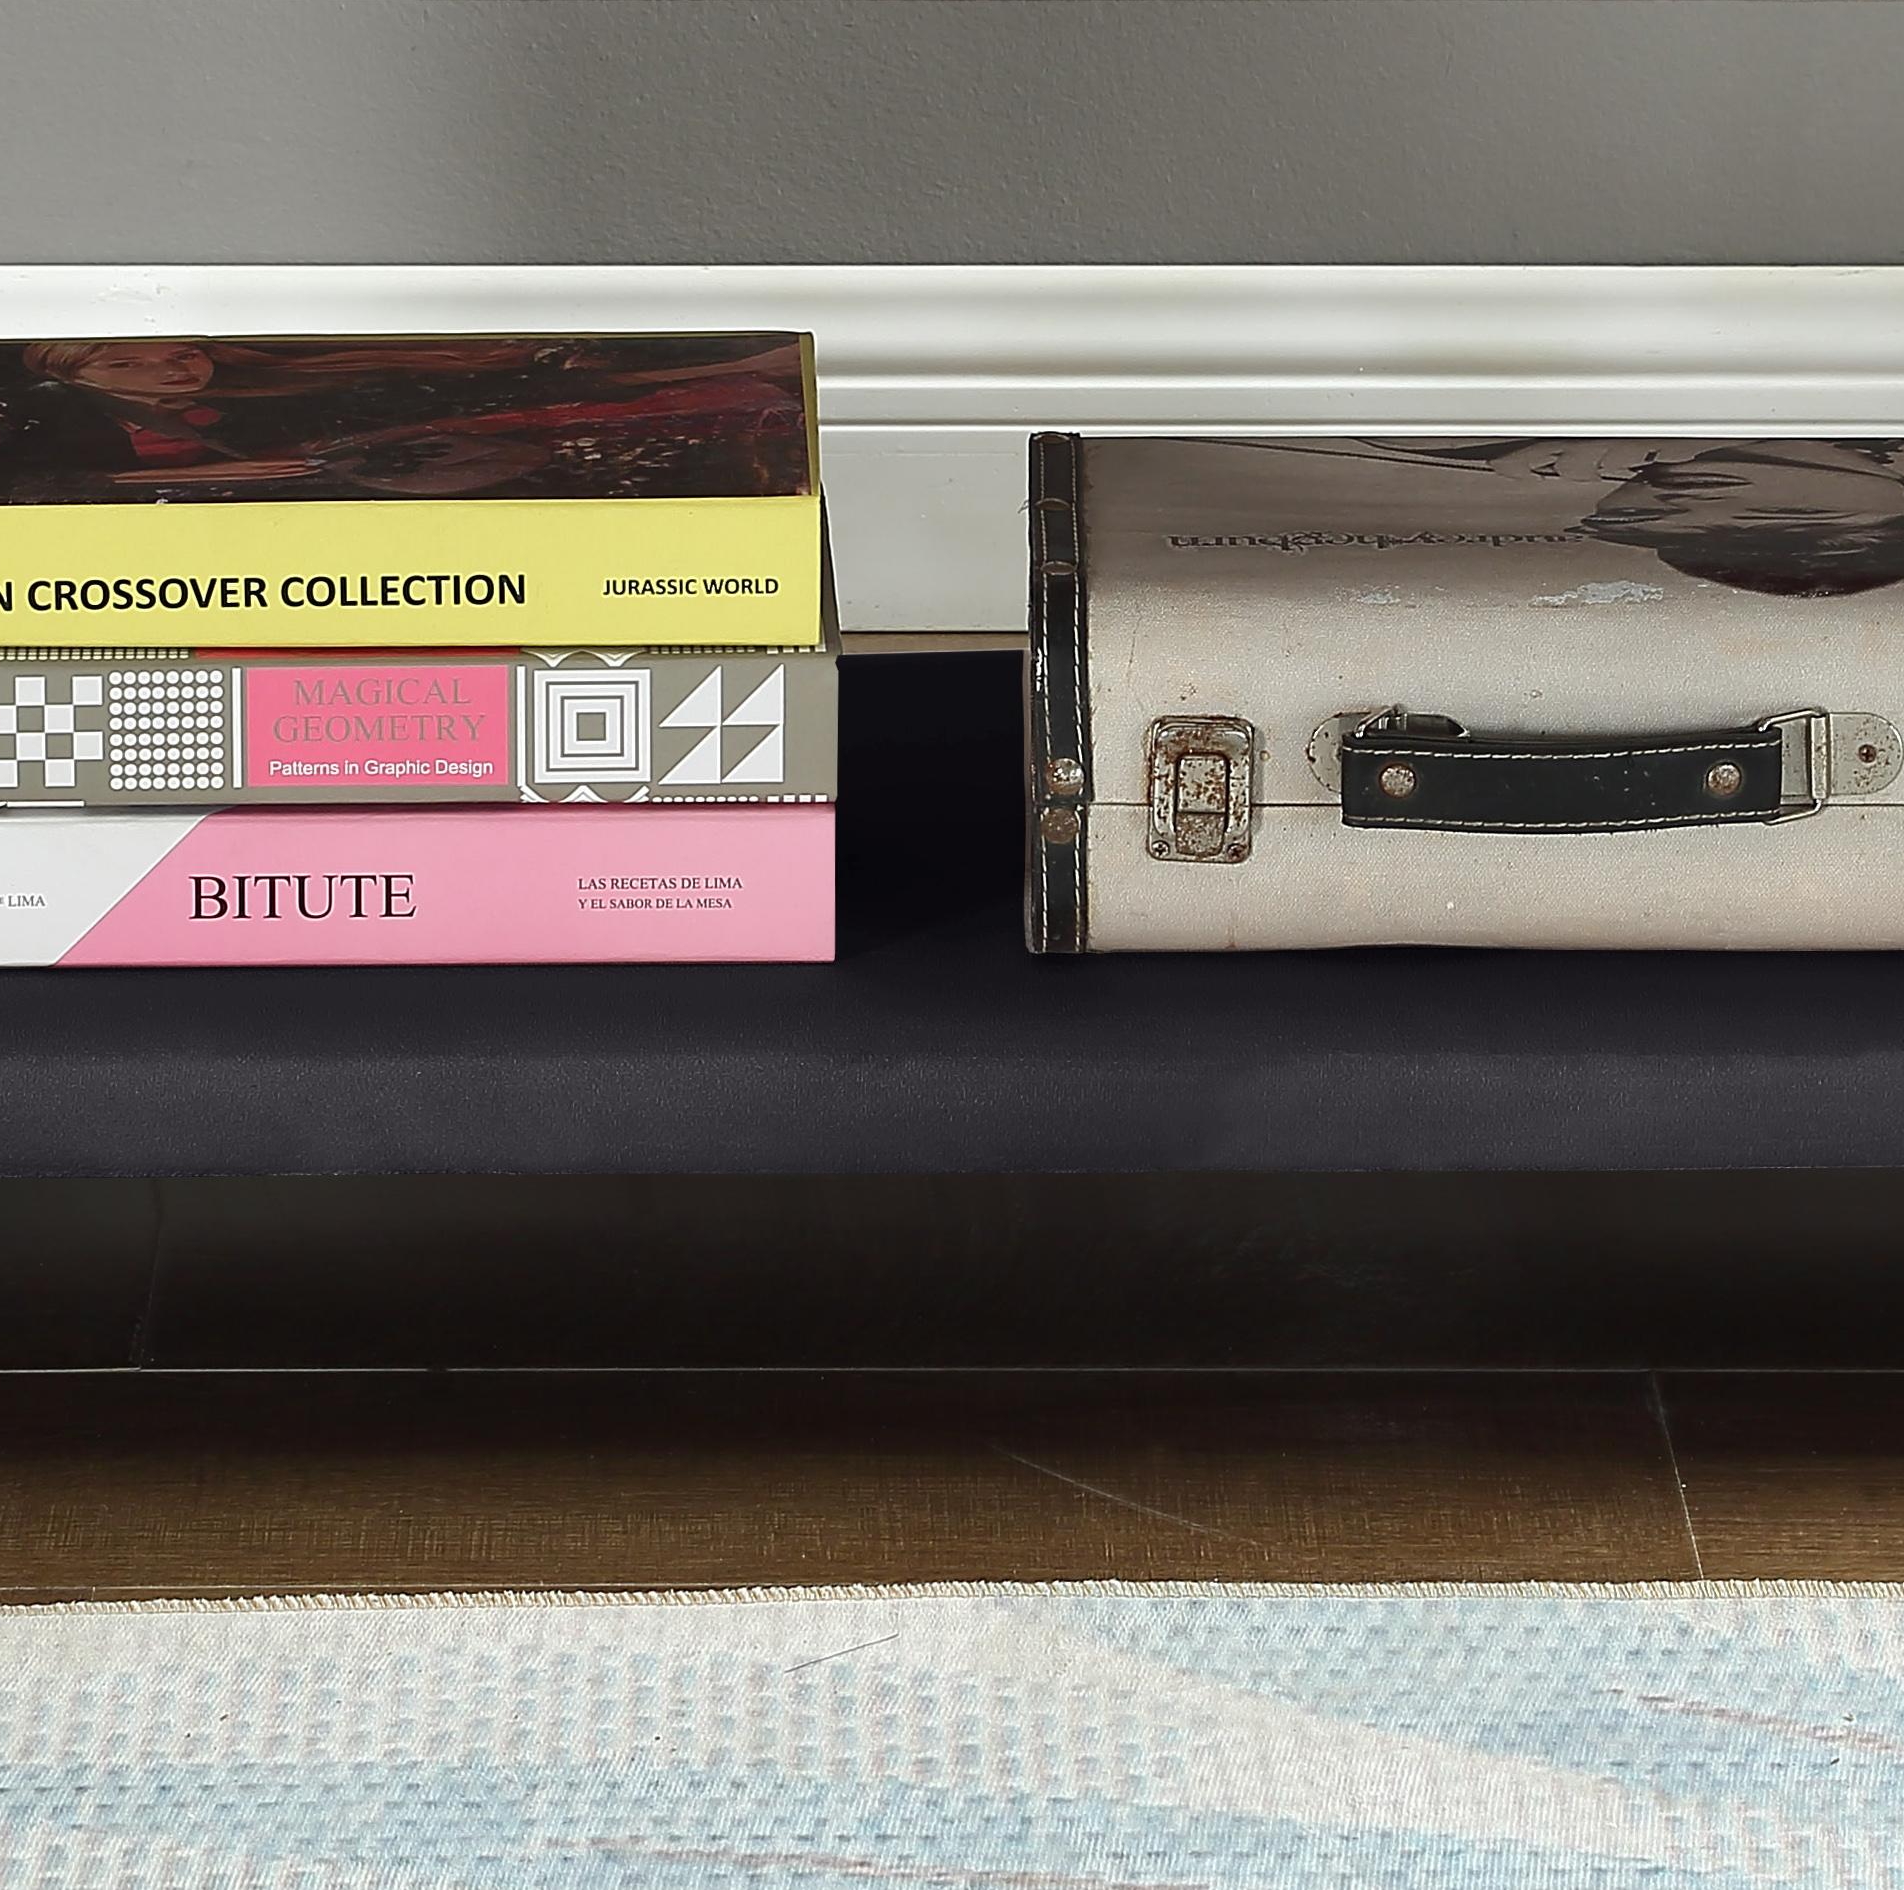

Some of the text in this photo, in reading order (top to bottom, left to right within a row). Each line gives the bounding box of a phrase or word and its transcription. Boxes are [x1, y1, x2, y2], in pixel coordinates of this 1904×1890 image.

[27, 577, 268, 611] CROSSOVER
[280, 573, 527, 608] COLLECTION
[603, 578, 779, 596] JURASSIC WORLD
[294, 677, 472, 706] MAGICAL
[272, 713, 487, 743] GEOMETRY
[269, 759, 494, 779] Patterns in Graphic Design
[578, 877, 743, 890] LAS RECETAS DE LIMA
[7, 894, 46, 908] LIMA
[188, 874, 418, 920] BITUTE
[578, 897, 733, 909] Y EL SABOR DE LA MESA
